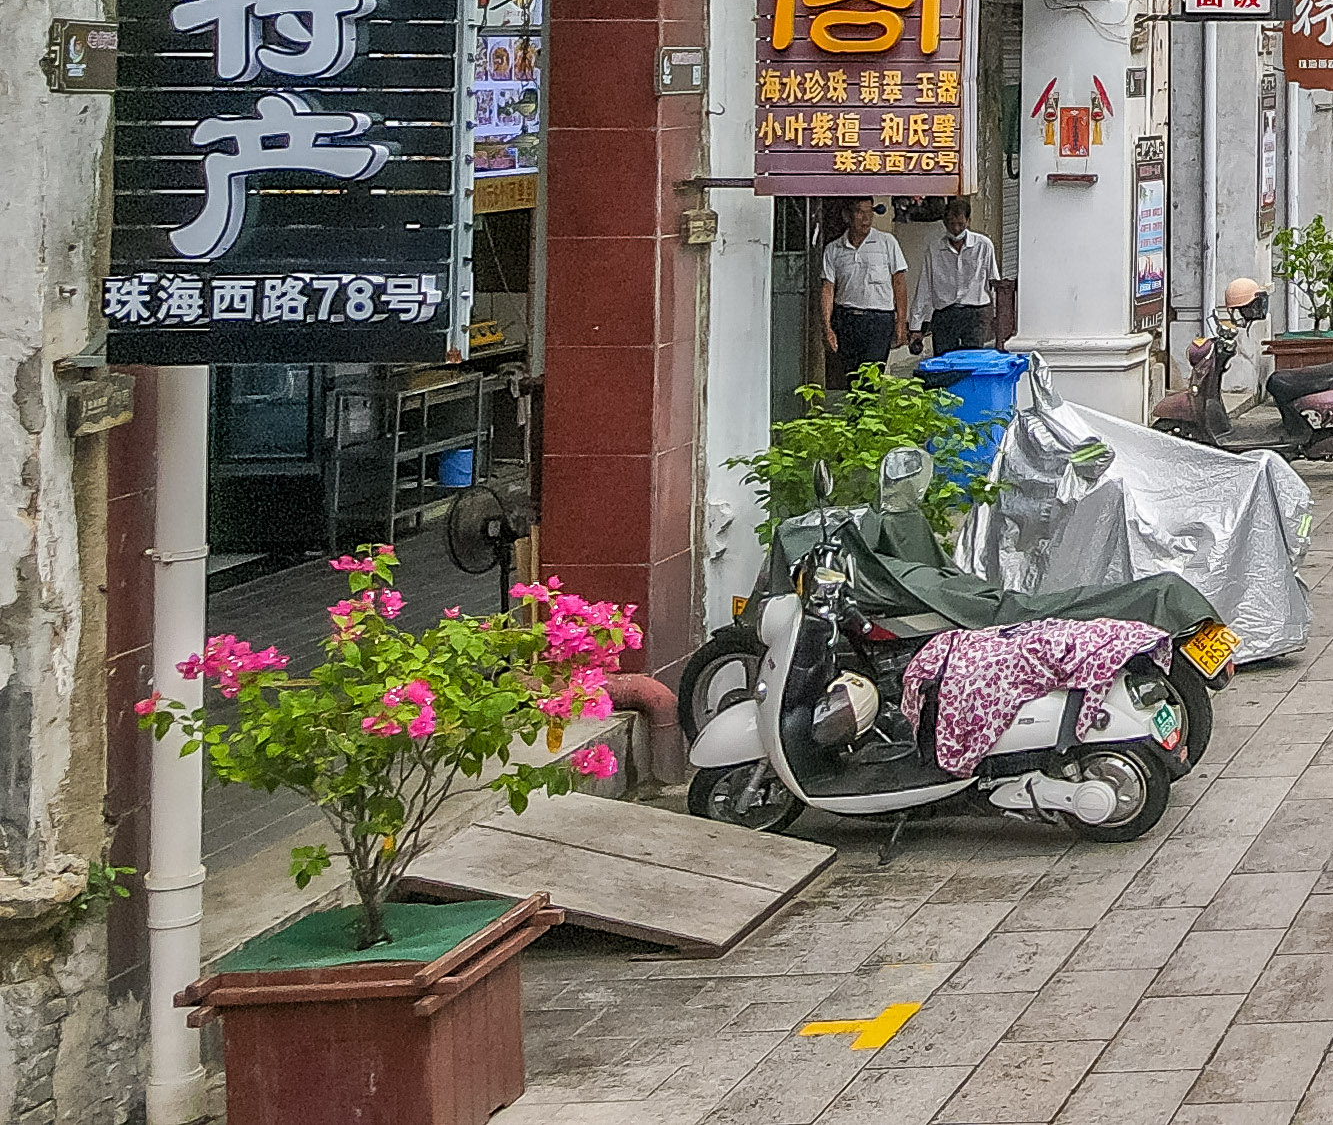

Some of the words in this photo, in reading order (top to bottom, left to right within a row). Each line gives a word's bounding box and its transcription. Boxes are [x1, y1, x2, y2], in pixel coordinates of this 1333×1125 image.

[760, 70, 847, 104] 海水珍珠
[860, 70, 903, 104] 翡翠
[916, 71, 958, 104] 玉器
[759, 112, 860, 147] 小叶紫檀
[881, 113, 957, 147] 和氏璧
[833, 152, 957, 172] 珠海西76号
[104, 275, 441, 323] 珠海西路78号
